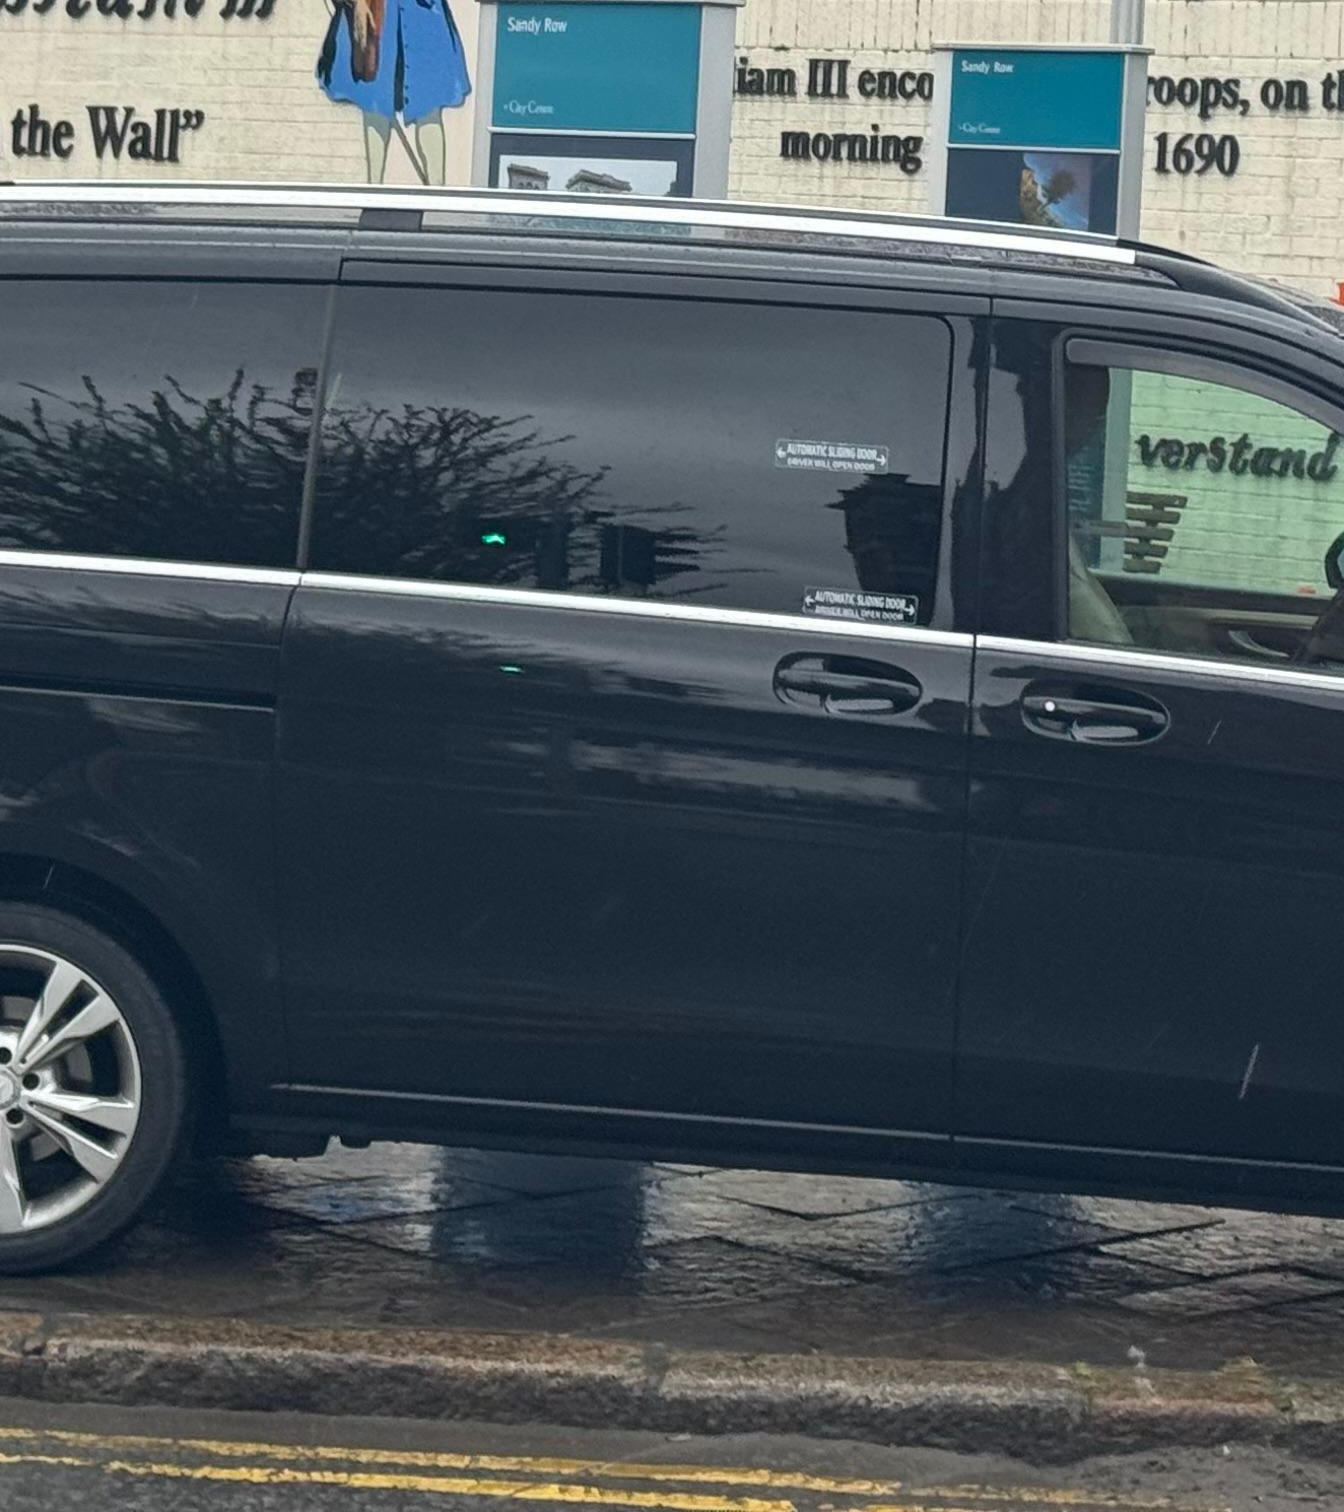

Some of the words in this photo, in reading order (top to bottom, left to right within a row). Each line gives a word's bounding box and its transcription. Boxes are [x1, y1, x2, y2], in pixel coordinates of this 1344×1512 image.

[507, 17, 541, 35] Sandy
[544, 18, 567, 34] Row
[961, 60, 991, 75] Sandy
[992, 61, 1014, 73] Row
[1260, 78, 1311, 112] on
[11, 105, 75, 157] the
[780, 123, 924, 175] morning
[1154, 131, 1240, 177] 1690
[787, 443, 827, 457] AUTOMATIC
[1134, 430, 1342, 481] verstand
